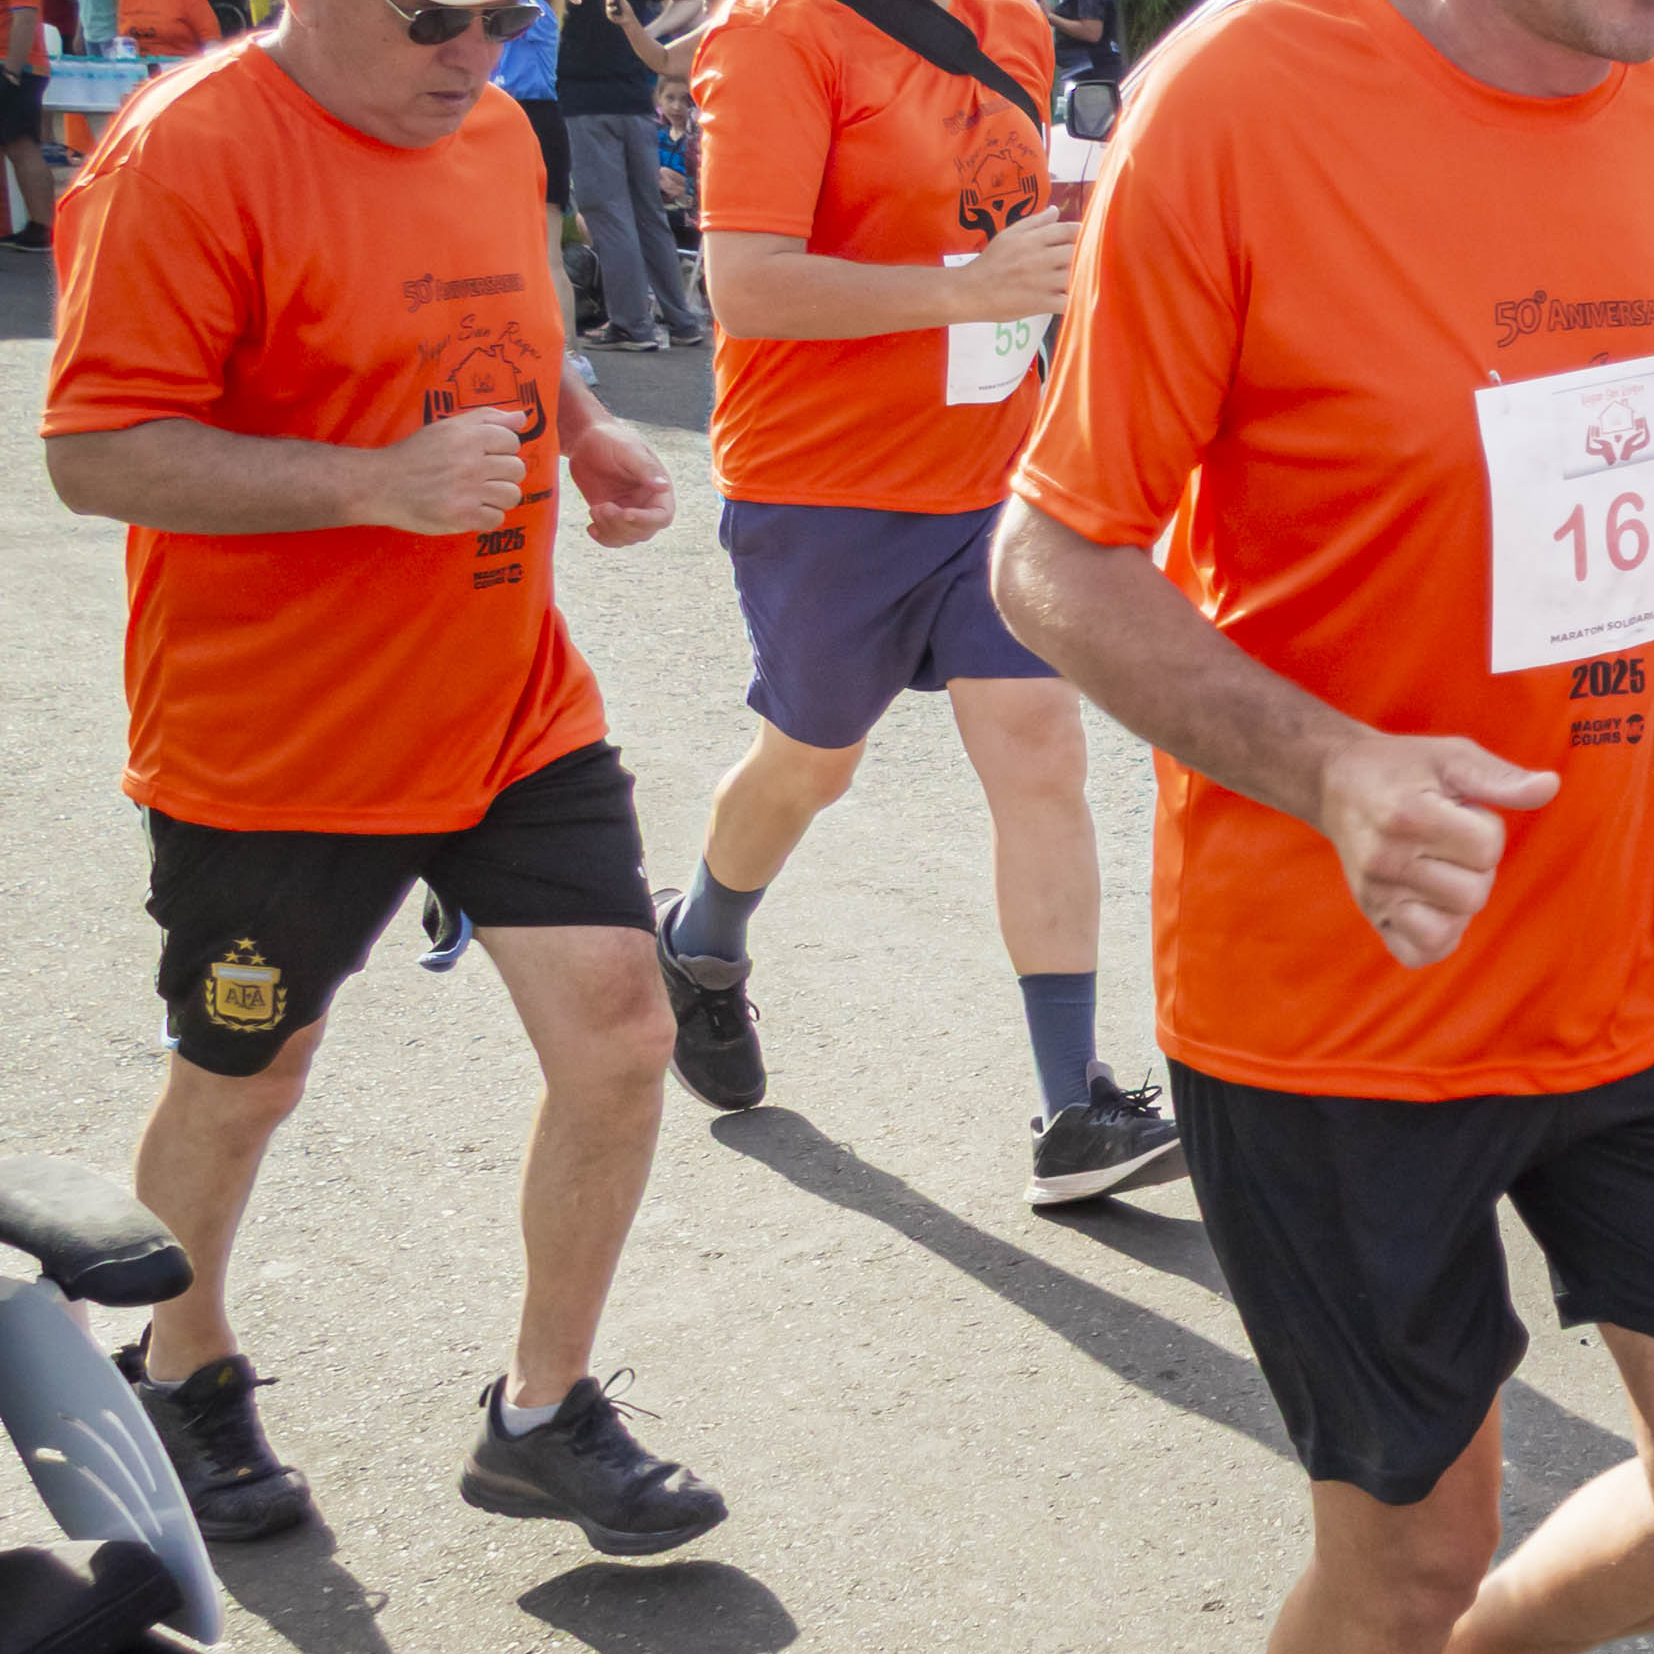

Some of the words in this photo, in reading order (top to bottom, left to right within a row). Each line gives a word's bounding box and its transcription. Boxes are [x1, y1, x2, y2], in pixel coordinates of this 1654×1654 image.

[476, 526, 526, 558] 2025
[1550, 624, 1605, 643] MARATON
[1569, 658, 1646, 700] 2025
[1571, 731, 1622, 747] COURS
